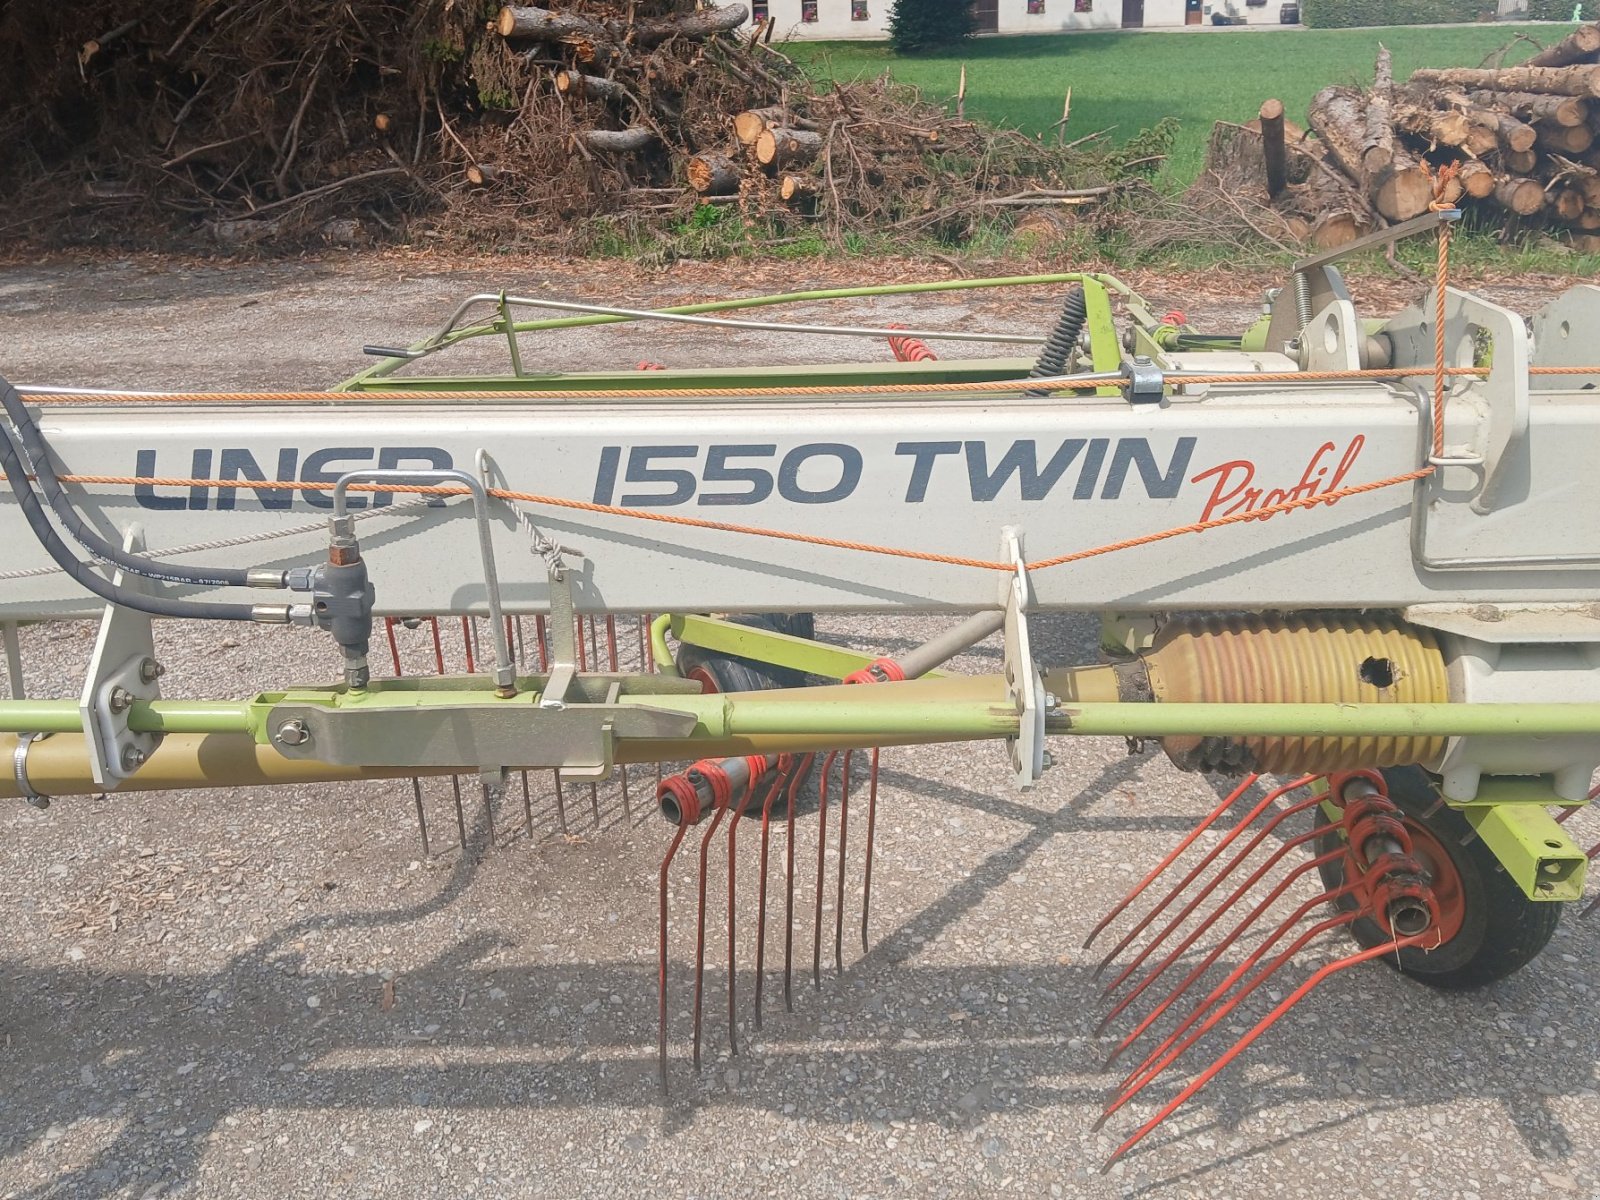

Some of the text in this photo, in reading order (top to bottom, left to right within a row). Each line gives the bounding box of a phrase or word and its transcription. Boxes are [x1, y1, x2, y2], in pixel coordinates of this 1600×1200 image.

[135, 434, 1365, 532] LINER 1550 TWIN Profil
